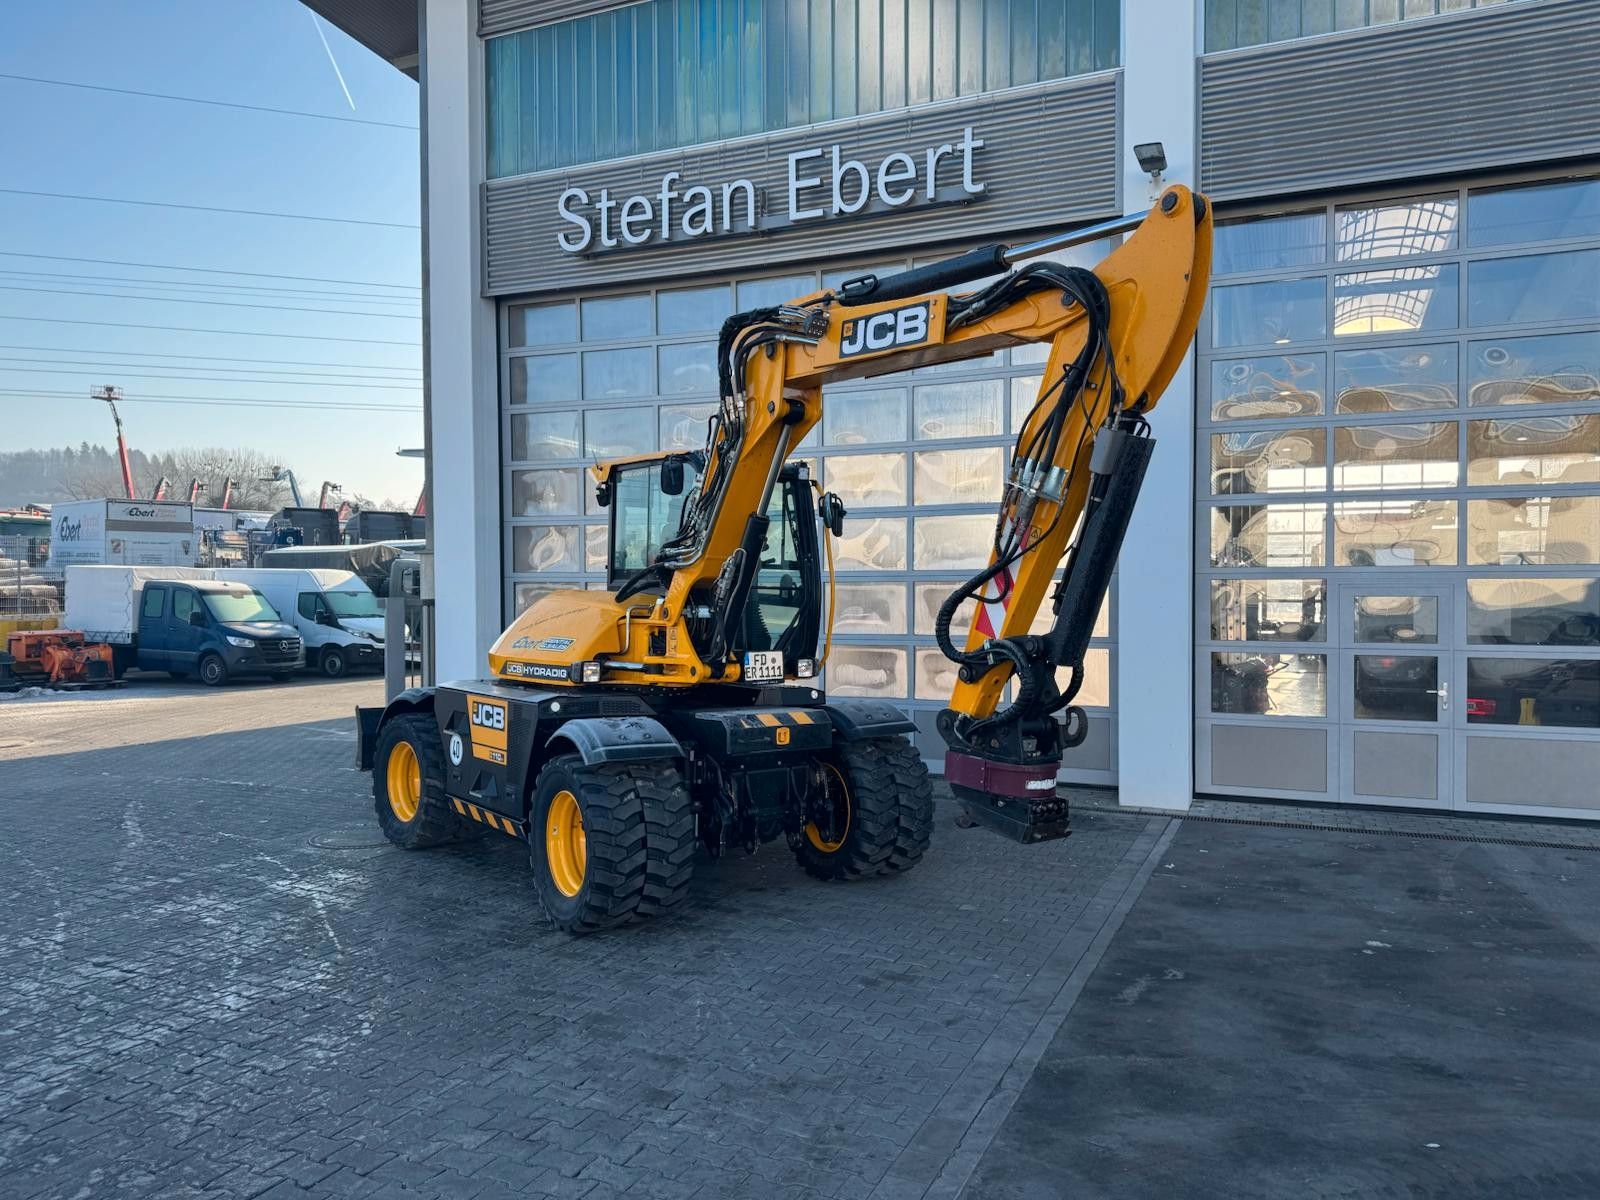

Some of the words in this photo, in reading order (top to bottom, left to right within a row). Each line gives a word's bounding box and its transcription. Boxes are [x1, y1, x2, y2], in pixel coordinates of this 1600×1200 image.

[557, 170, 758, 254] Stefan
[787, 126, 987, 221] Ebert
[842, 306, 928, 354] JCB
[128, 507, 155, 517] Ebert
[60, 516, 82, 541] Ebert
[753, 654, 767, 665] FD
[507, 664, 522, 673] JCB
[523, 665, 567, 678] HYDRADIG
[473, 703, 504, 729] JCB
[452, 739, 460, 759] 40
